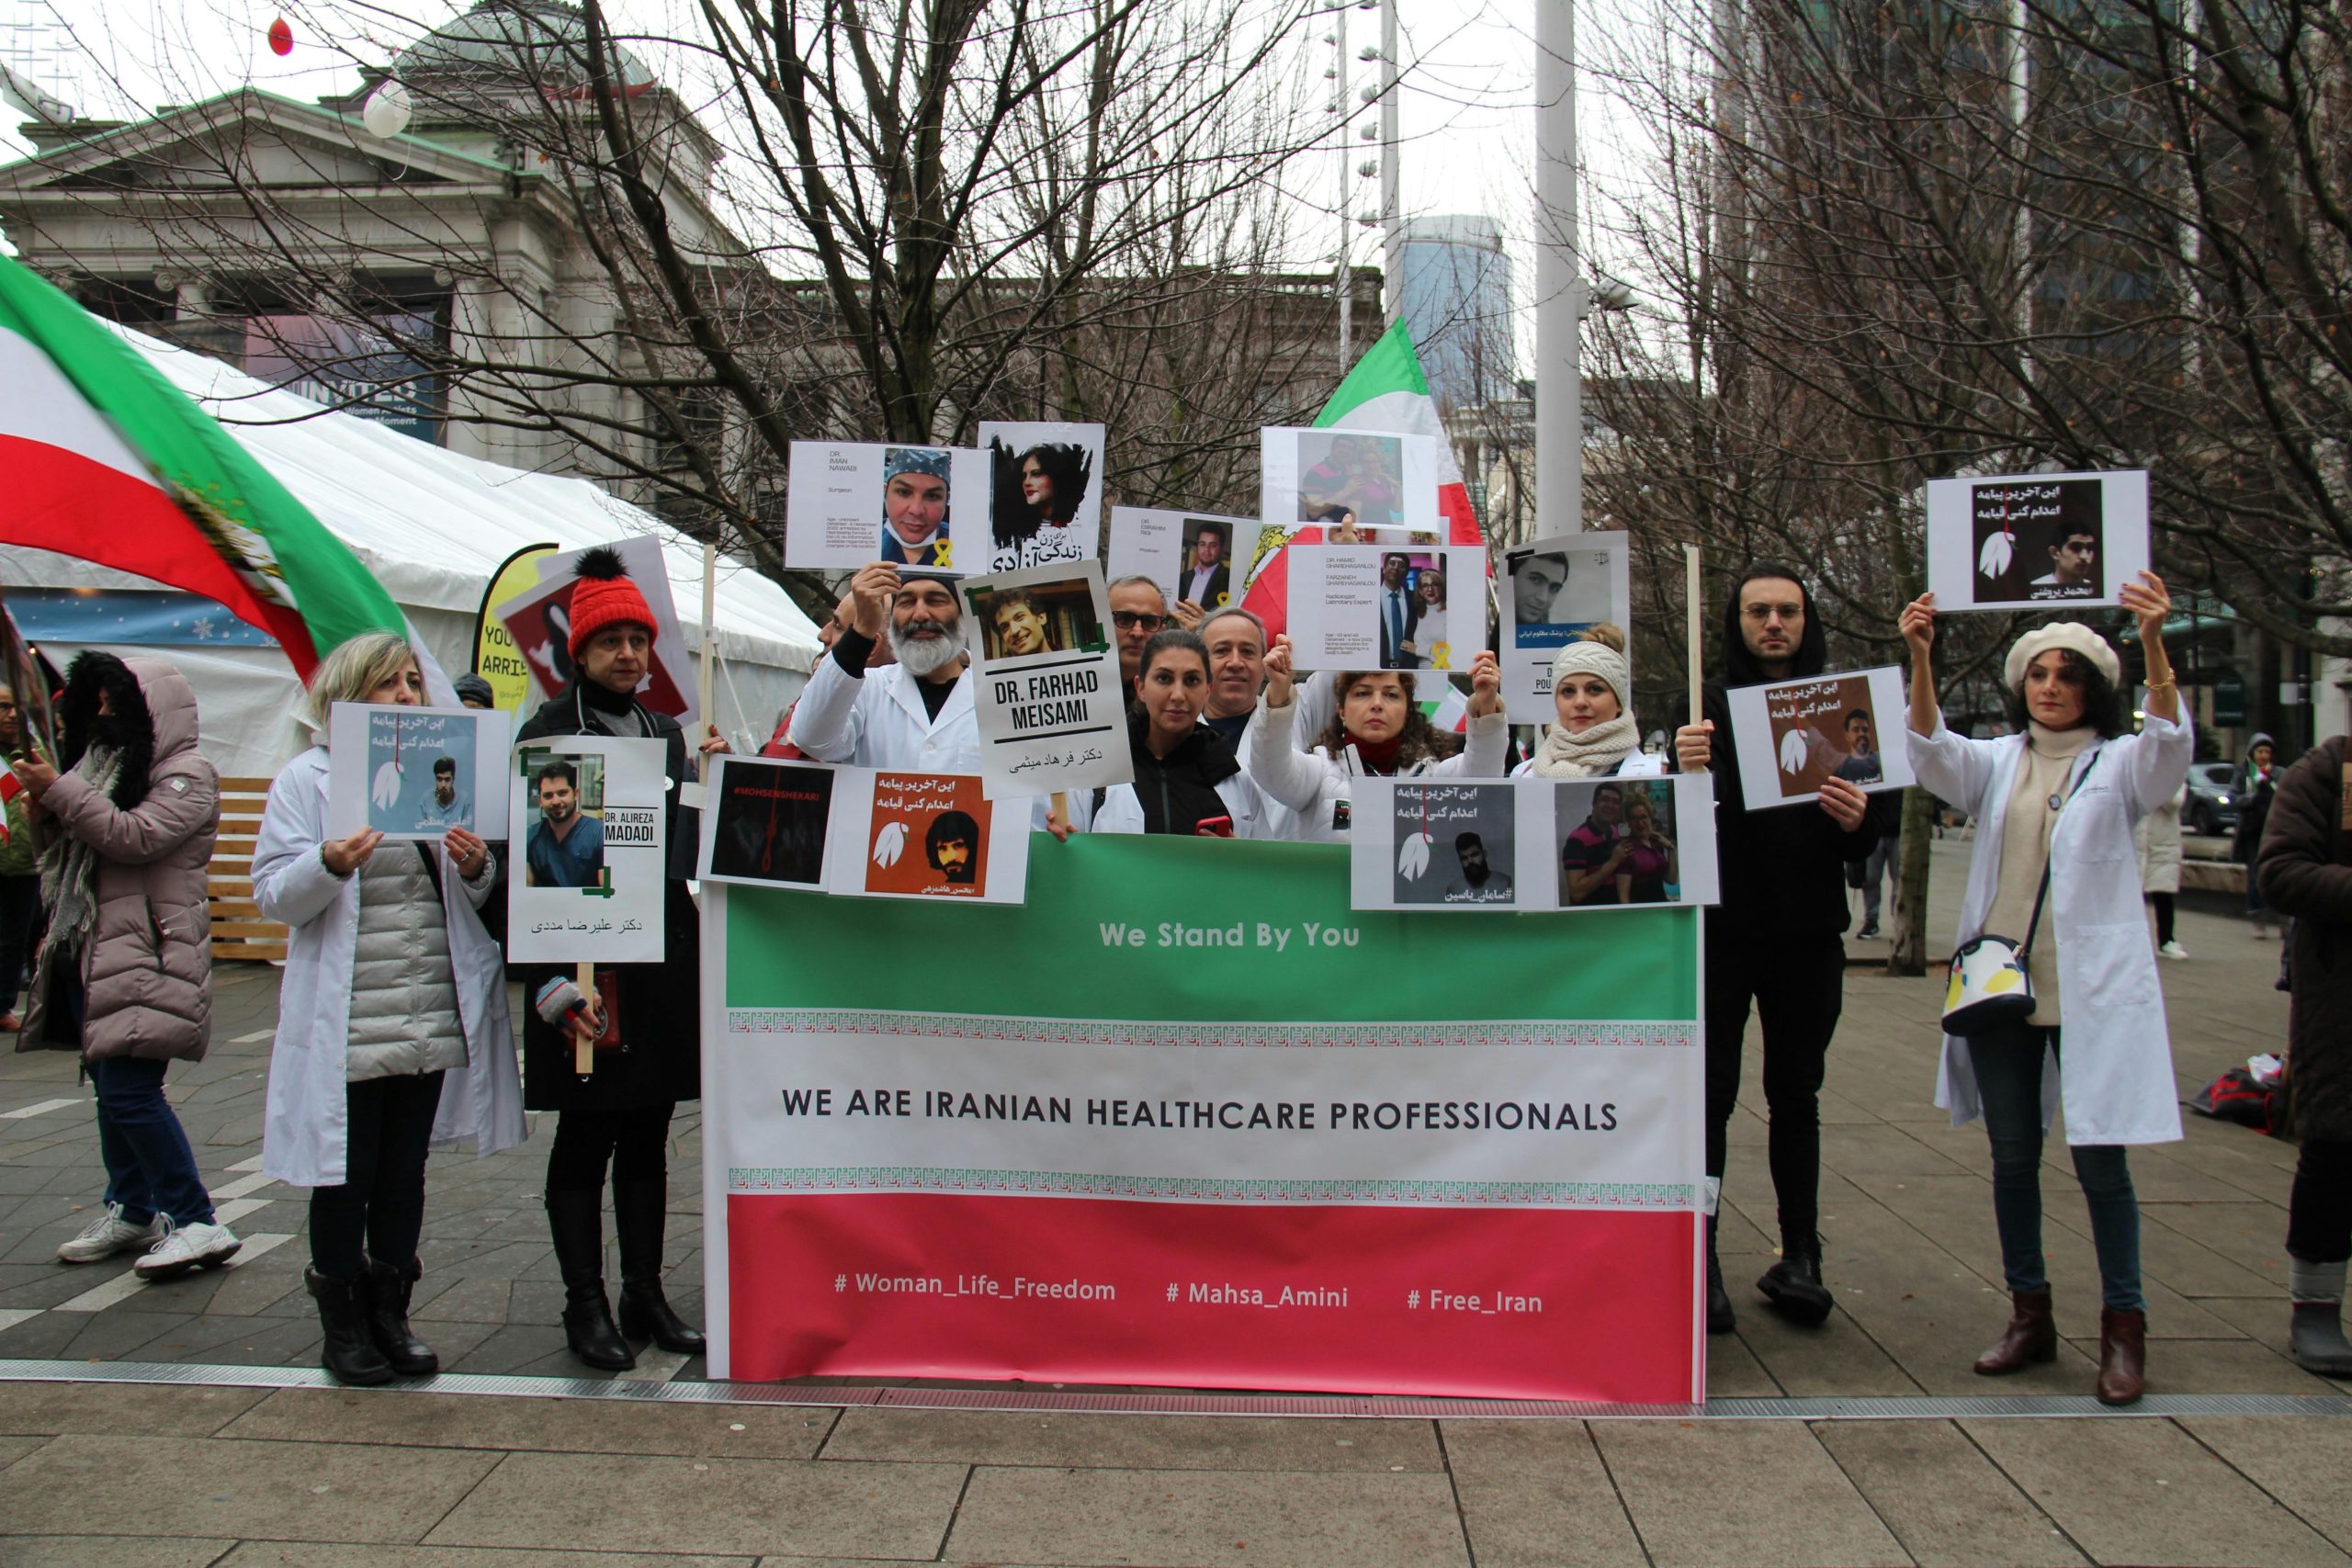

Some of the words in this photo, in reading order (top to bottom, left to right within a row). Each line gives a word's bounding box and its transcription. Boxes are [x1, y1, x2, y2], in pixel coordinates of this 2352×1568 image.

[2007, 486, 2041, 501] آخرین
[2041, 486, 2061, 499] این
[1977, 506, 2006, 519] قیامه
[2007, 504, 2030, 520] کنی
[2030, 505, 2061, 519] اعدام
[1040, 534, 1053, 547] زن
[1038, 541, 1082, 561] زندگی
[993, 546, 1041, 573] آزادی
[995, 681, 1024, 705] DR.
[1028, 670, 1099, 700] FARHAD
[1793, 684, 1822, 698] آخرین
[1822, 682, 1838, 694] این
[1012, 698, 1089, 730] MEISAMI
[1817, 700, 1842, 716] اعدام
[399, 716, 428, 729] آخرین
[429, 717, 445, 731] این
[419, 738, 445, 750] اعدام
[1078, 748, 1102, 766] دکتر
[1010, 756, 1042, 774] میثمی
[905, 779, 938, 793] آخرین
[937, 780, 956, 793] این
[1426, 786, 1459, 801] آخرین
[1459, 787, 1477, 801] این
[876, 796, 903, 809] قیامه
[904, 797, 925, 811] کنی
[926, 799, 954, 812] اعدام
[605, 812, 618, 823] DR.
[621, 813, 654, 824] ALIREZA
[1396, 806, 1424, 819] قیامه
[1426, 806, 1447, 821] کنی
[1449, 807, 1477, 821] اعدام
[605, 825, 653, 841] MADADI
[531, 922, 563, 933] مددی
[567, 919, 613, 934] علیرضا
[617, 919, 643, 934] دکتر
[1099, 922, 1147, 947] We
[1158, 922, 1244, 947] Stand
[1256, 922, 1292, 952] By
[1302, 922, 1360, 947] You
[782, 1089, 831, 1116] WE
[845, 1089, 911, 1117] ARE
[925, 1090, 1071, 1123] IRANIAN
[1087, 1099, 1315, 1130] HEALTHCARE
[1330, 1101, 1617, 1131] PROFESSIONALS
[855, 1273, 1116, 1301] Woman_Life_Freedom
[1188, 1283, 1349, 1308] Mahsa_Amini
[1430, 1290, 1543, 1314] Free_Iran
